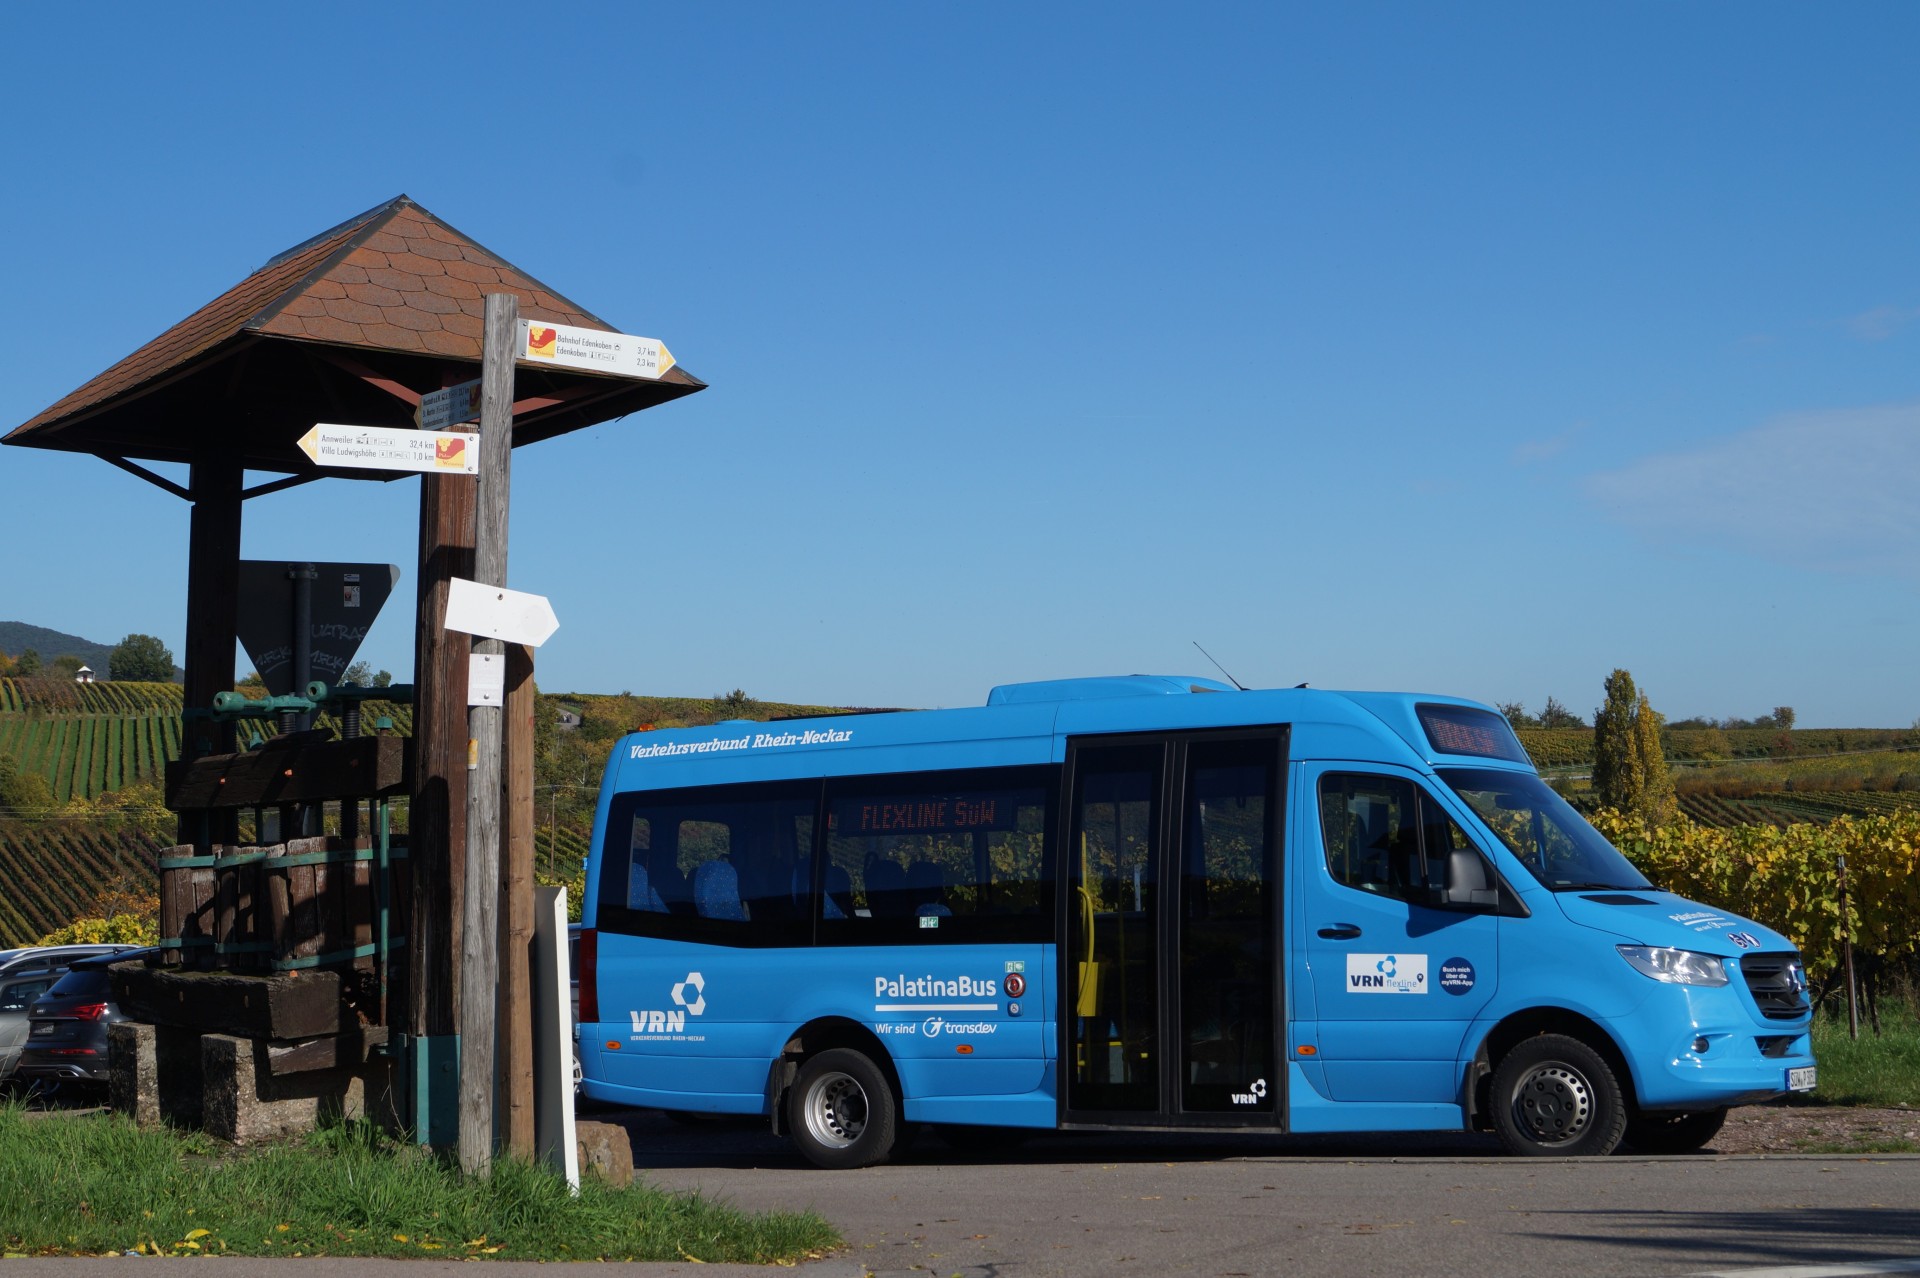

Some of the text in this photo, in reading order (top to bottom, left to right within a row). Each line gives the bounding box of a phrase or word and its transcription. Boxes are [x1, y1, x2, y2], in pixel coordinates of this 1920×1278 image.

[557, 334, 581, 346] Bahnhof
[582, 339, 612, 351] Edenkoben
[556, 347, 587, 358] Edenkoben
[647, 348, 656, 357] km
[647, 359, 656, 368] km
[321, 434, 353, 444] Annweiler
[409, 440, 435, 449] 32,4 km
[321, 446, 377, 458] Villa Ludwigshöhe
[413, 452, 423, 461] 1,0
[425, 453, 434, 461] km
[630, 729, 853, 759] Verkehrsverbund Rhein-Neckar
[861, 802, 947, 830] FLEXLINE
[875, 974, 997, 997] PalatinaBus
[1351, 975, 1383, 987] VRN
[1386, 979, 1417, 988] flexline
[630, 1010, 685, 1033] VRN
[875, 1022, 997, 1034] Wir sind transdev
[1231, 1094, 1257, 1104] VRN
